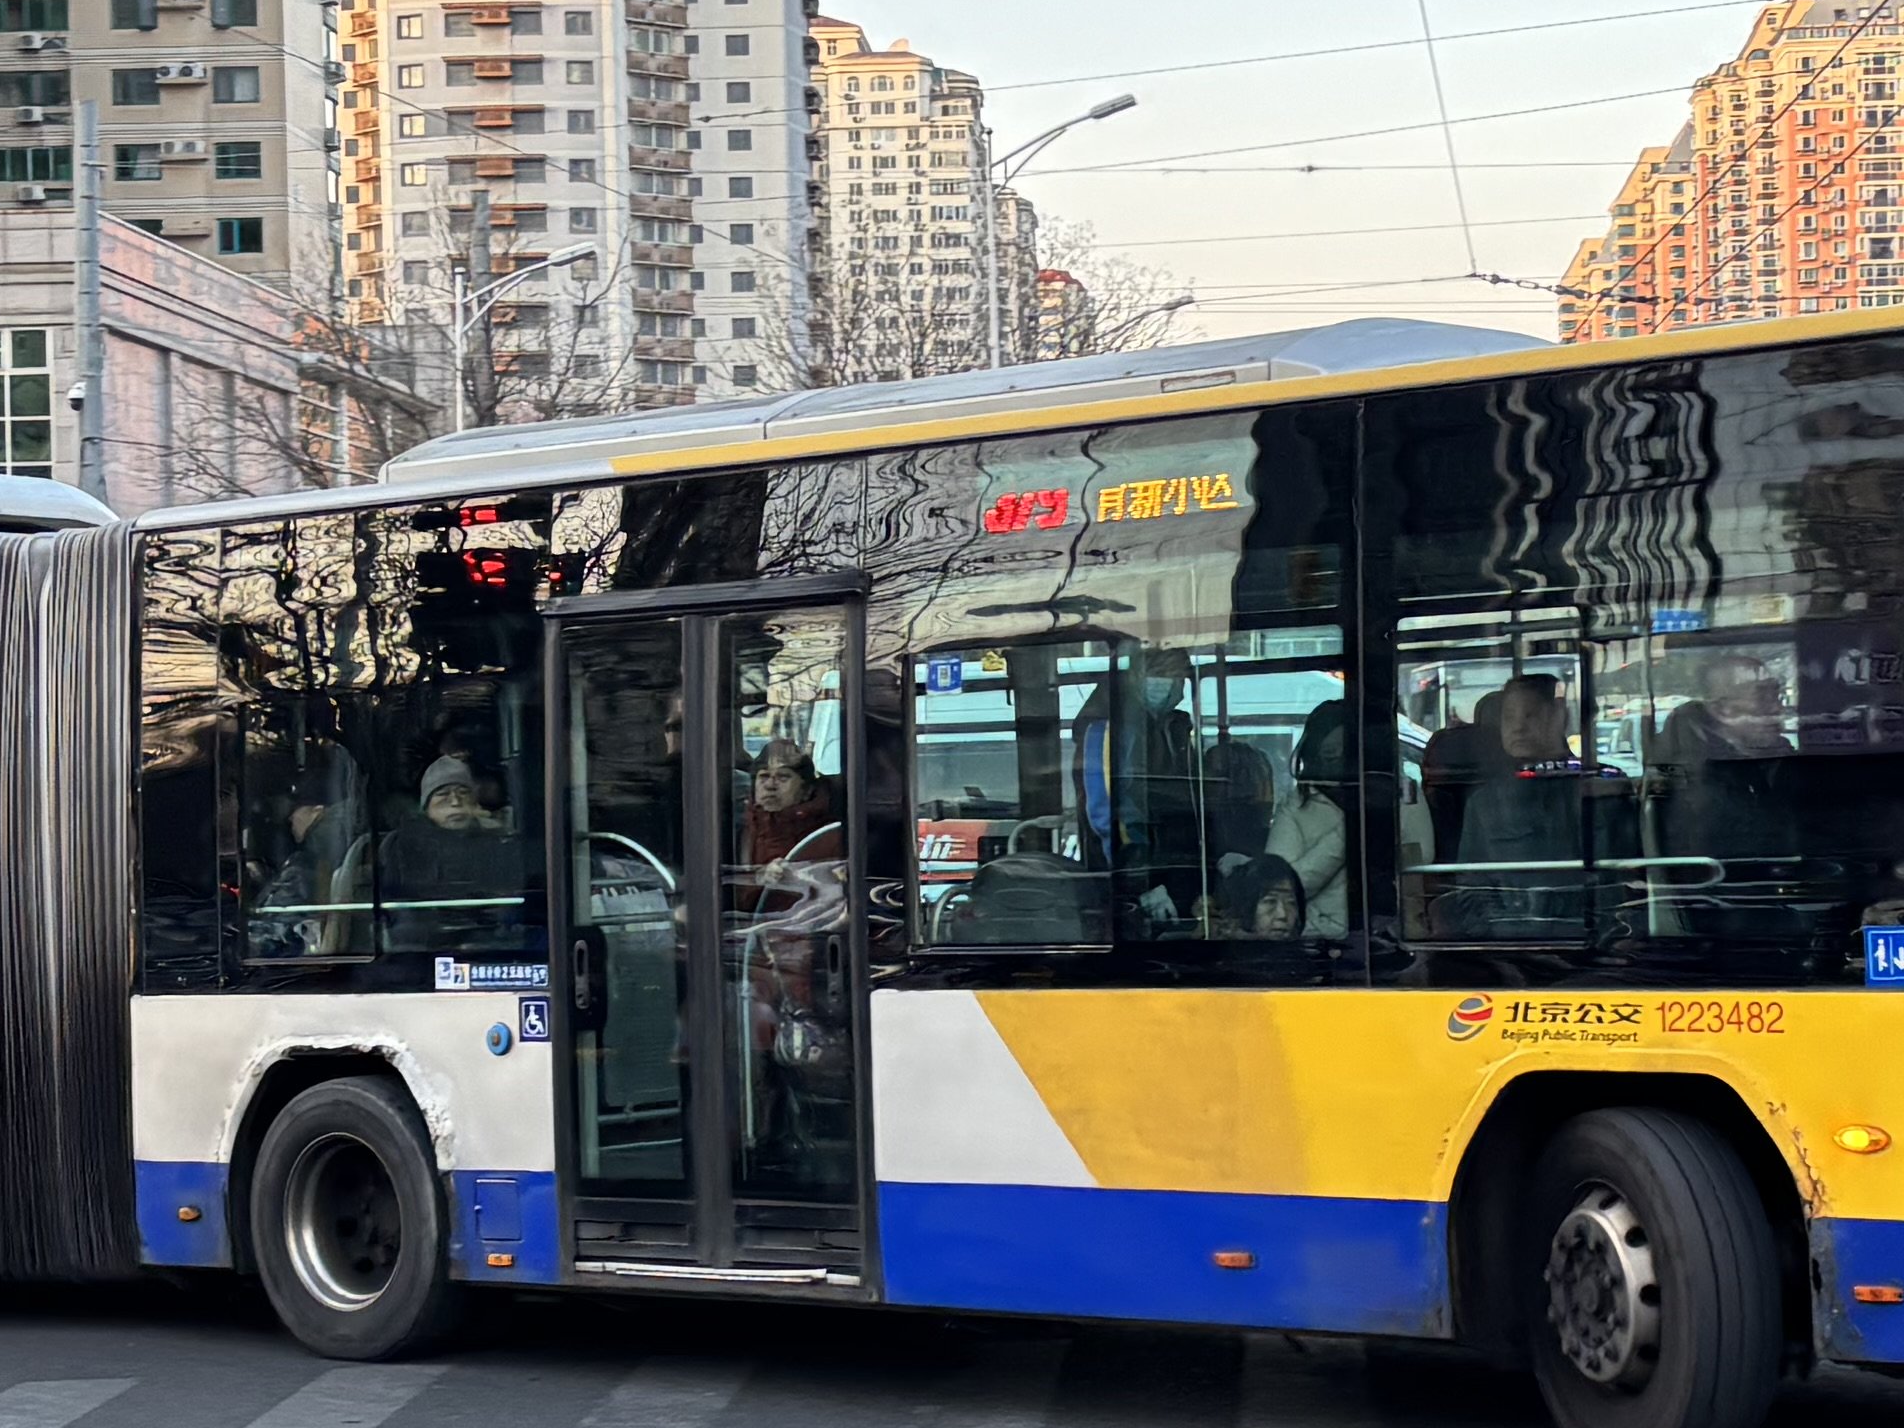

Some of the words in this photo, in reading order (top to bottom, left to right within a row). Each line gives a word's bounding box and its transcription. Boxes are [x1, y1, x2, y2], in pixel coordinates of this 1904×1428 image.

[1504, 1001, 1643, 1024] 北京公交
[1655, 1001, 1785, 1034] 1223482
[1501, 1028, 1539, 1043] Beijing
[1541, 1029, 1576, 1041] Public
[1578, 1029, 1639, 1045] Transport
